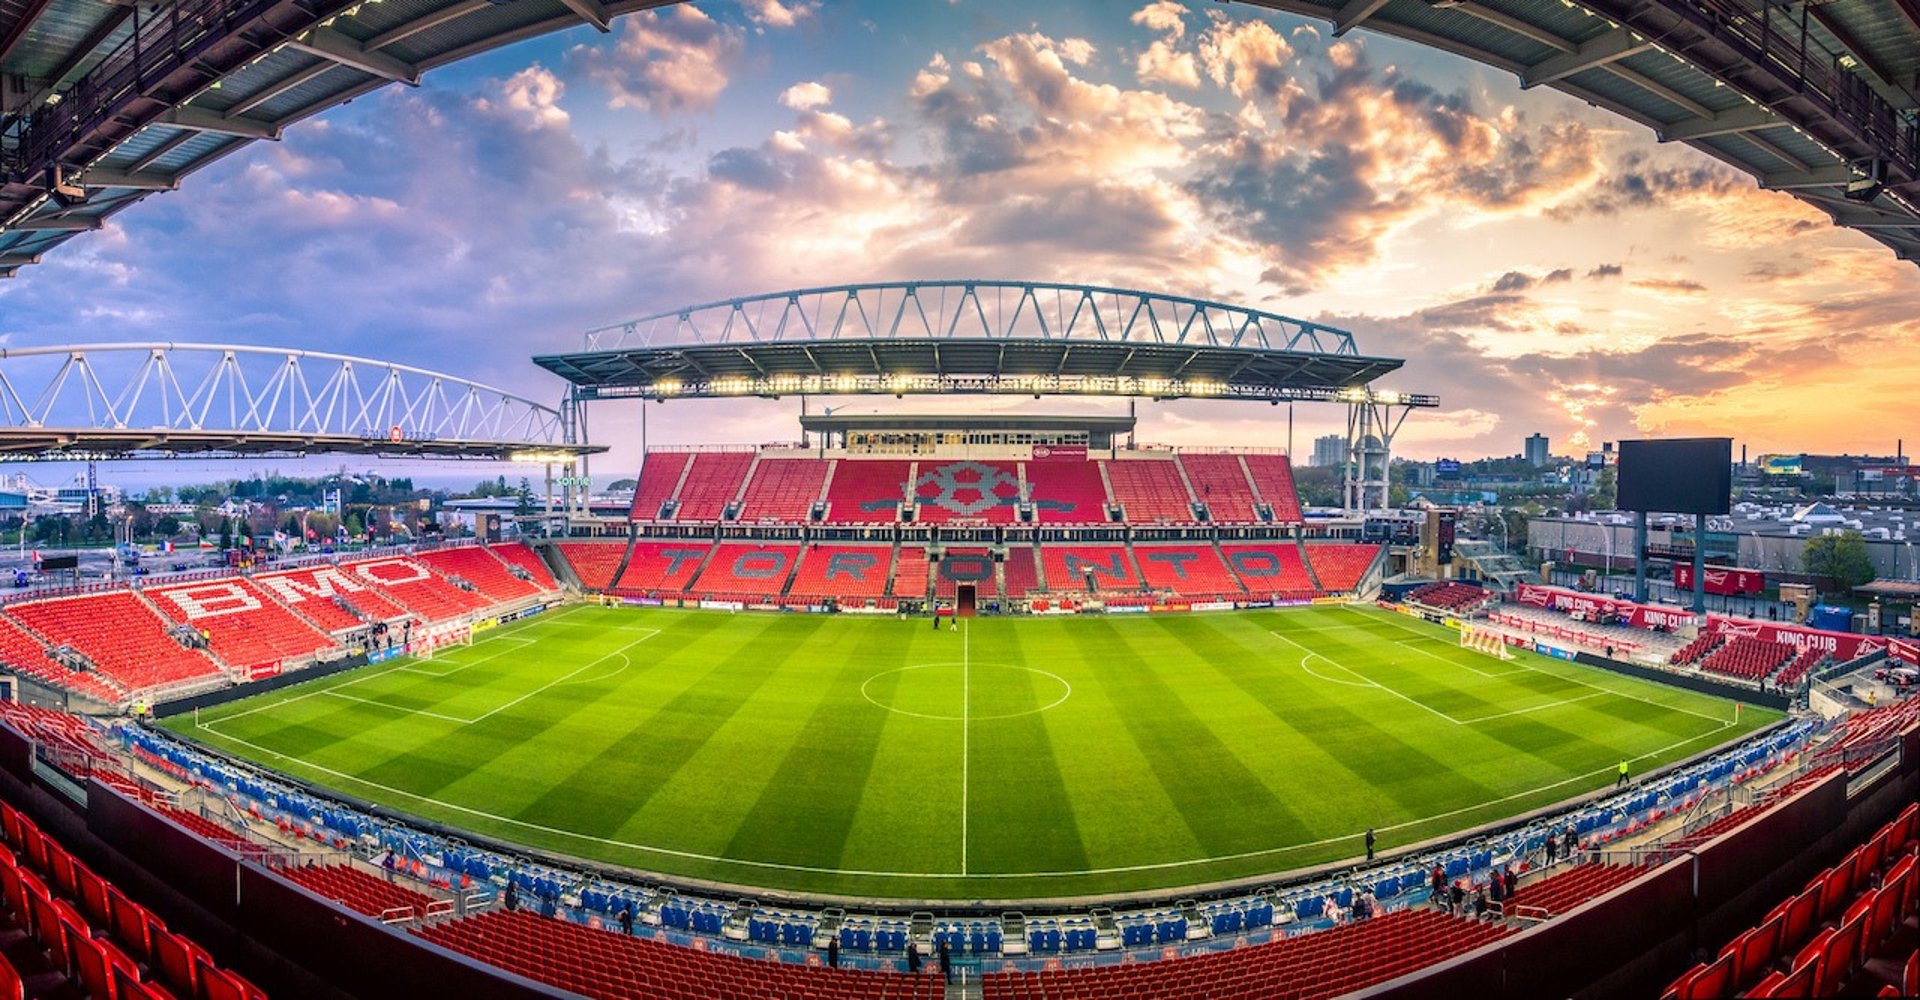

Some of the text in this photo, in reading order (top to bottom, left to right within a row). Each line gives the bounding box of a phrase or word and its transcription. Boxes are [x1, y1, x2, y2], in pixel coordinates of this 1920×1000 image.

[161, 559, 431, 619] BMO
[1644, 609, 1667, 626] KING
[1776, 630, 1804, 646] KING
